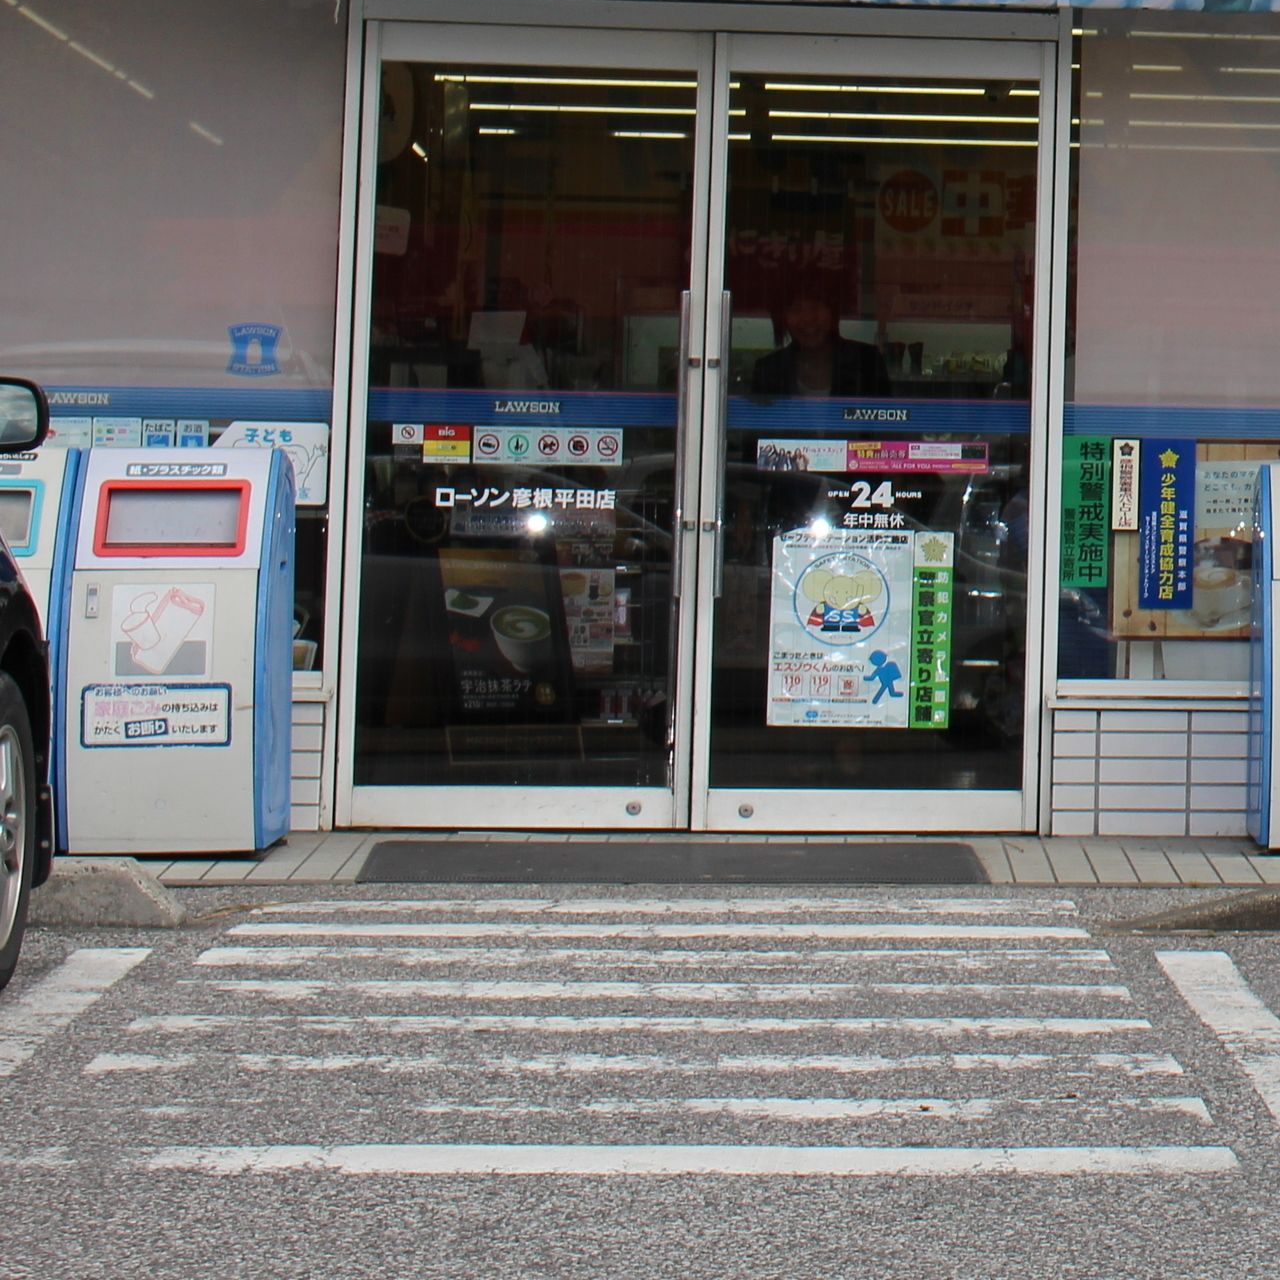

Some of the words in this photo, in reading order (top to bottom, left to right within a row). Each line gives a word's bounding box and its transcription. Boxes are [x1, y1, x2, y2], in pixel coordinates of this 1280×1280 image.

[883, 189, 936, 219] SALE
[494, 400, 560, 414] LAWSON
[843, 408, 907, 421] LAWSON
[144, 422, 172, 433] たばこ
[244, 428, 293, 442] 子ども
[129, 464, 224, 476] 紙・プラスチック類
[435, 487, 616, 509] ローソン彦根平田店
[850, 480, 894, 508] 24
[896, 491, 922, 499] HOURS
[843, 512, 905, 528] 年中無休
[1077, 441, 1105, 583] 特別警戒実施中
[1157, 472, 1176, 600] 少年健全育成協力店
[915, 571, 937, 722] 警察官立寄り店舗
[783, 675, 800, 684] 110
[811, 675, 829, 684] 119
[94, 687, 168, 697] お客様へのお願い
[127, 720, 166, 737] お断り
[172, 724, 218, 734] いたします
